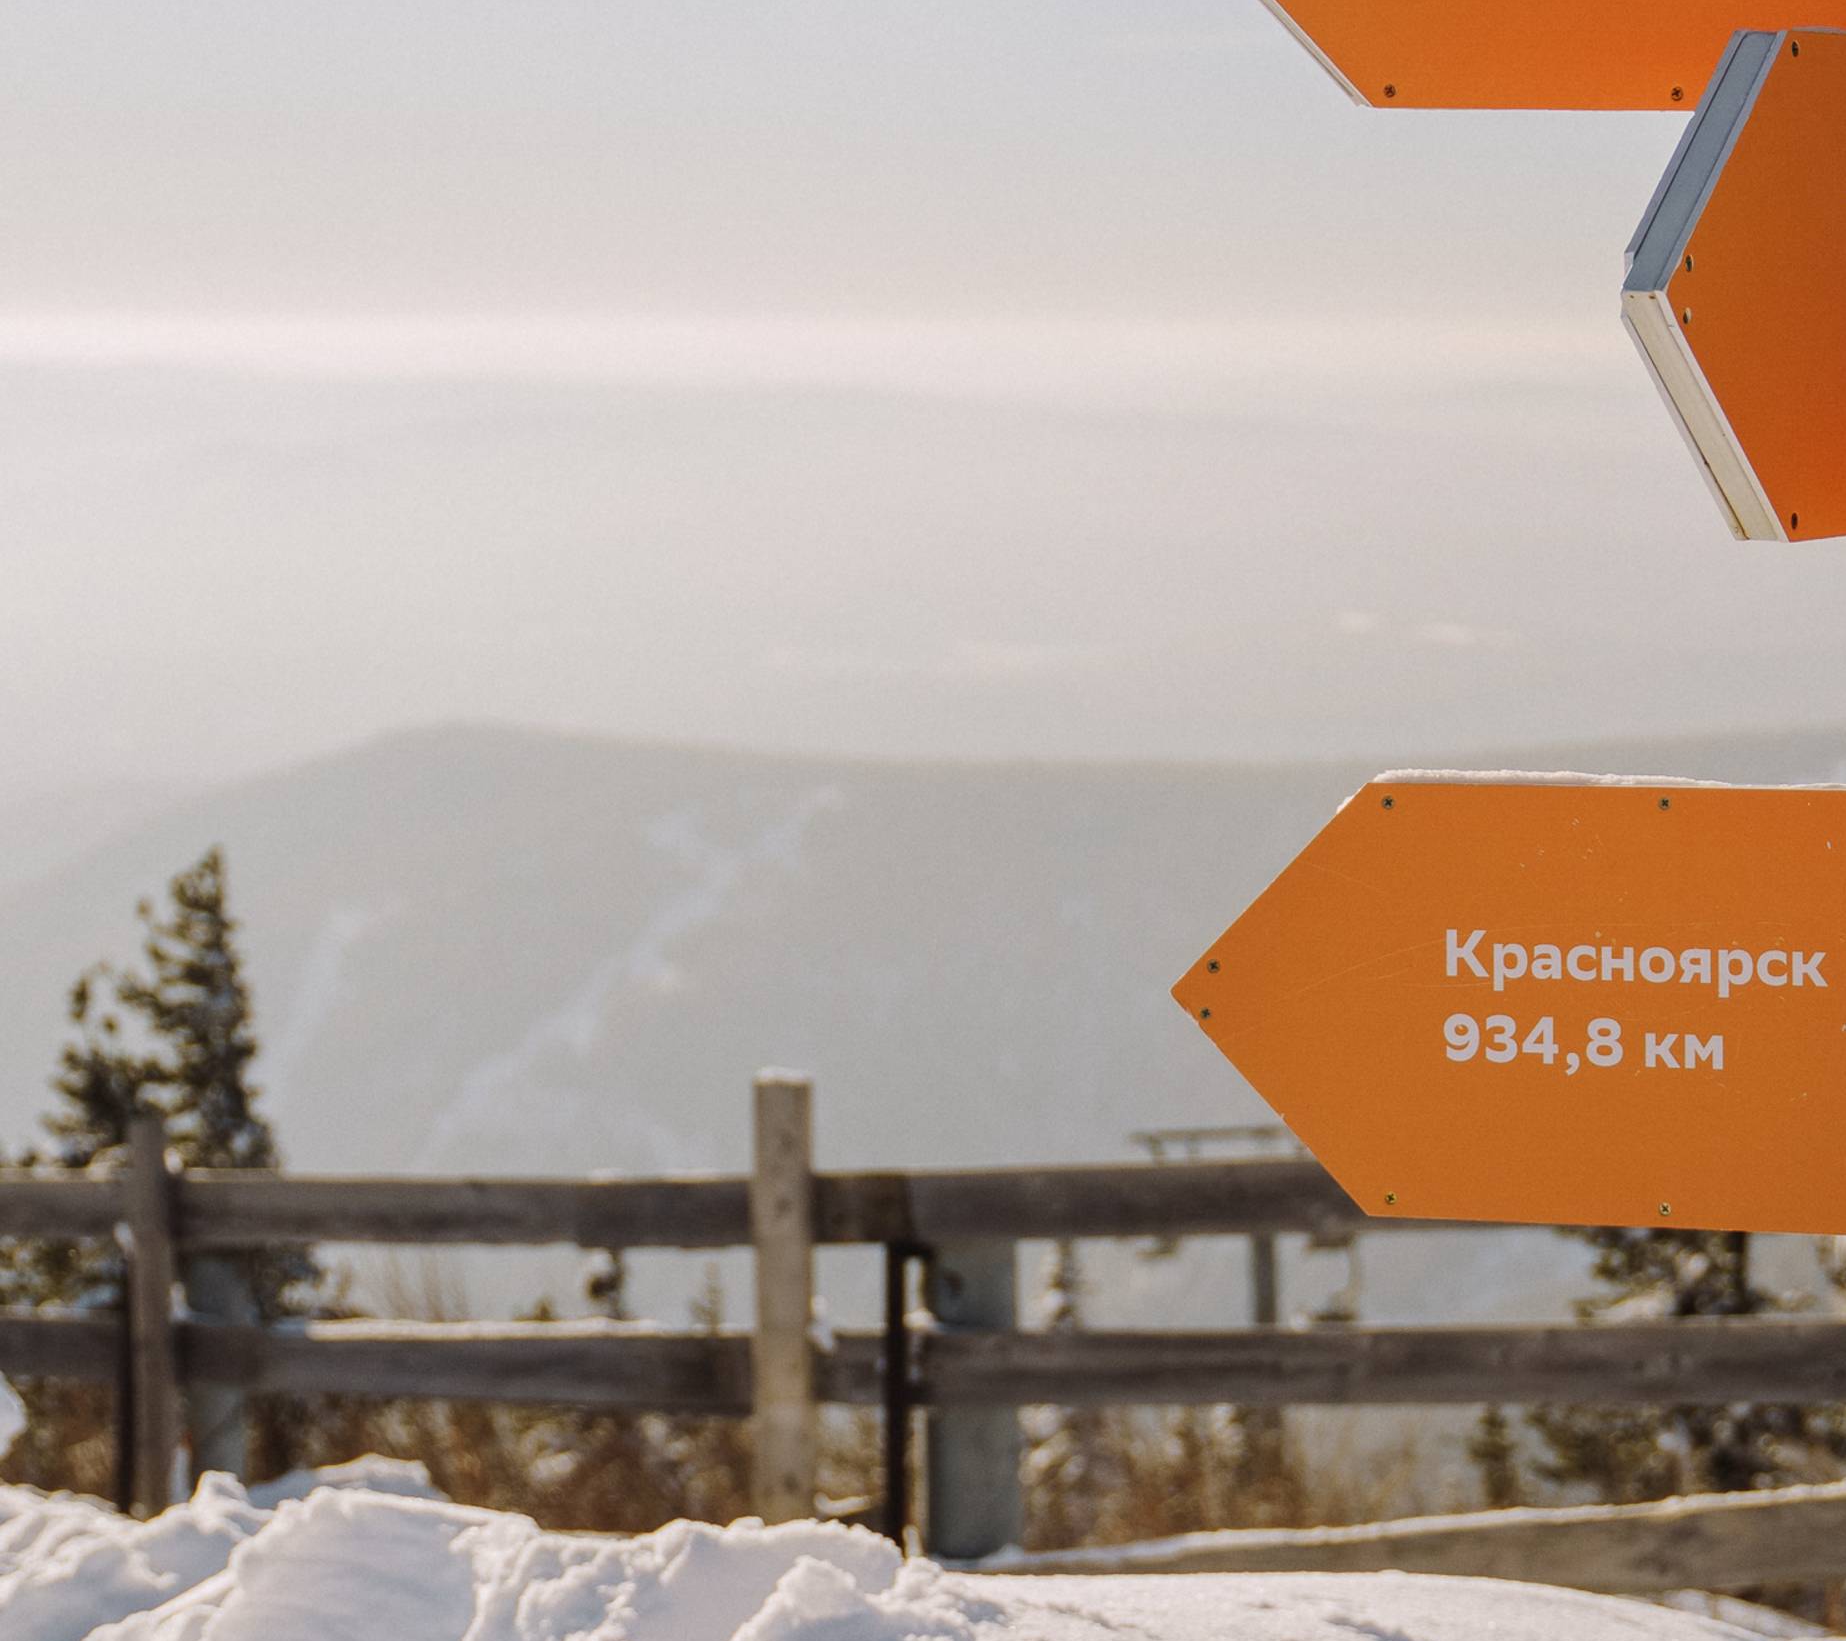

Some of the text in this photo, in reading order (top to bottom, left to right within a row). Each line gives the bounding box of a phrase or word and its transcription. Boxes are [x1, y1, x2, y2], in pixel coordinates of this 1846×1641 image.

[1444, 928, 1829, 998] Красноярск
[1443, 1013, 1726, 1077] 934,8 км
